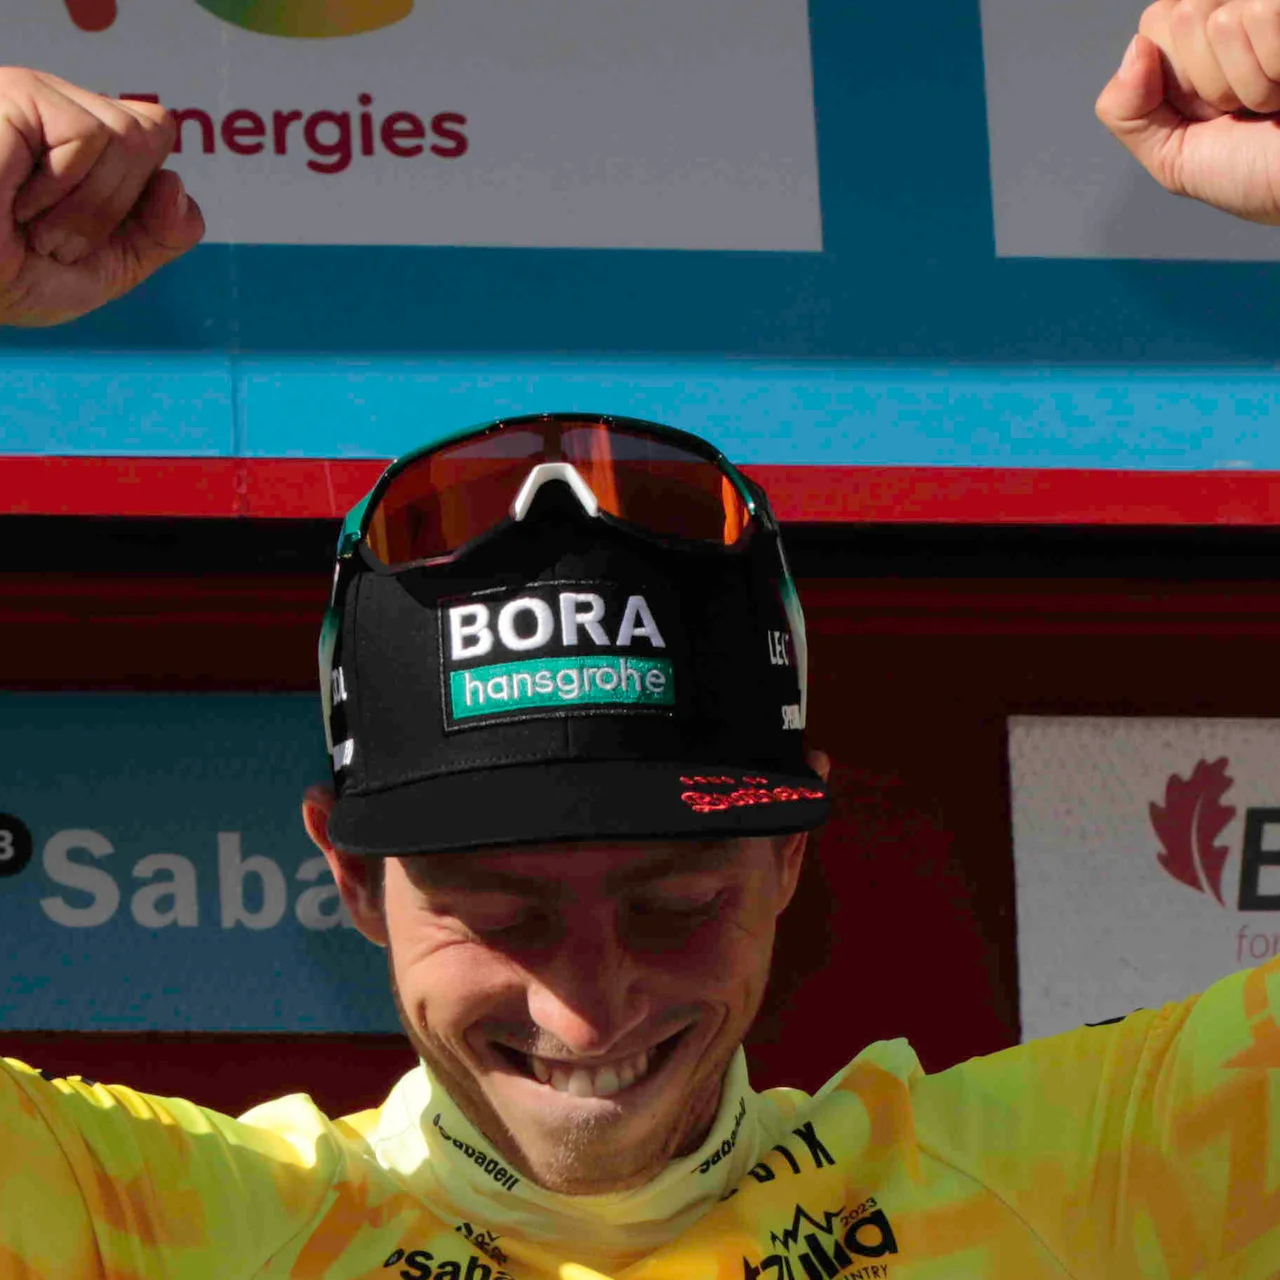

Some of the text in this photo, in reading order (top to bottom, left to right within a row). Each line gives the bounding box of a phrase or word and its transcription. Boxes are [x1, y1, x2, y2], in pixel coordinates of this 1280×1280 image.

[449, 592, 666, 661] BORA
[464, 659, 666, 708] hansgrohe
[40, 828, 352, 929] Saba
[839, 1197, 879, 1227] 2023
